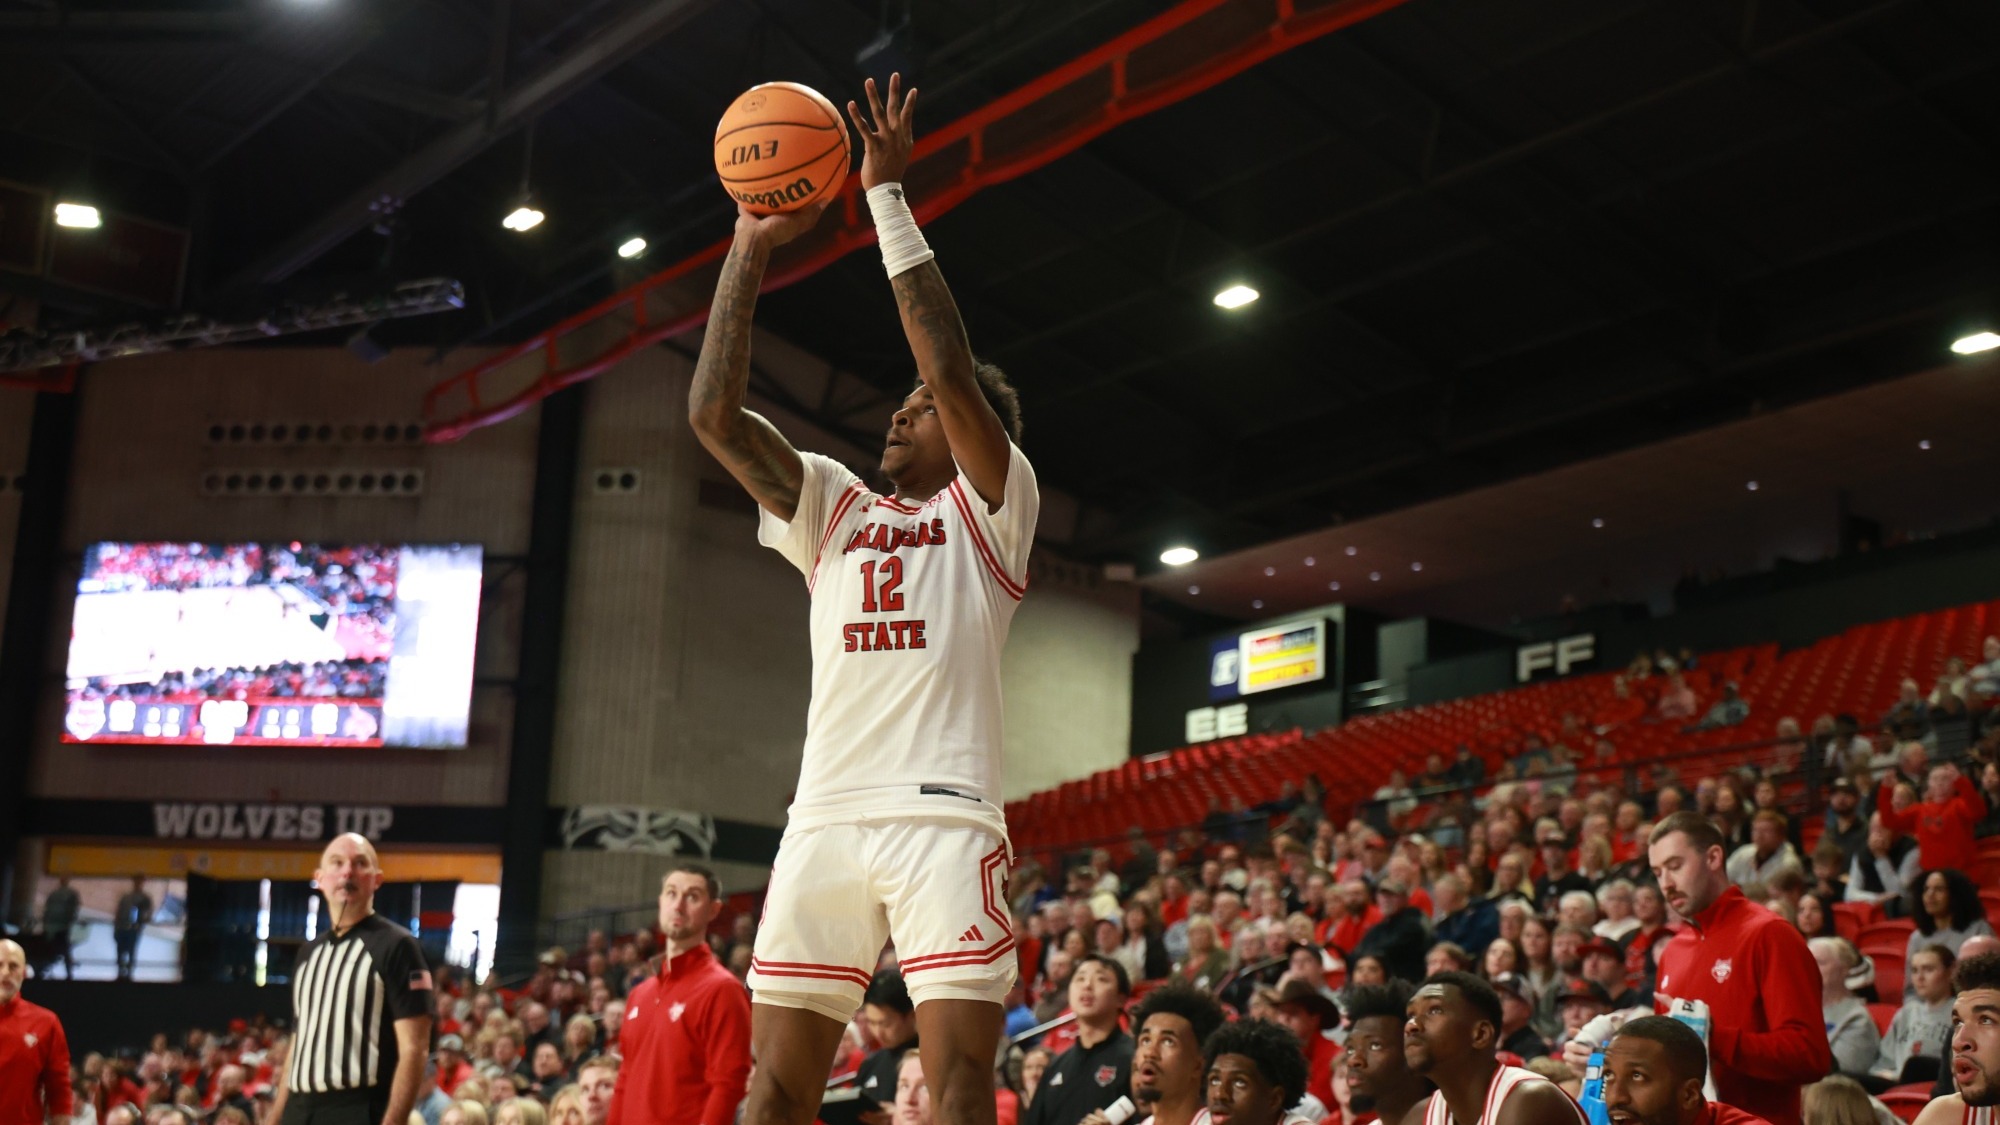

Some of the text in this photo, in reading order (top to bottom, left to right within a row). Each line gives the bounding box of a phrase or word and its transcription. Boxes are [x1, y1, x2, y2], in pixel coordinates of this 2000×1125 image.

[732, 140, 778, 165] EVO
[729, 177, 816, 209] Wilson
[843, 518, 946, 555] KANSAS
[860, 555, 905, 612] 12
[843, 620, 927, 653] STATE
[1517, 633, 1596, 682] FF
[1186, 703, 1249, 744] EE
[154, 803, 393, 840] WOLVES UP
